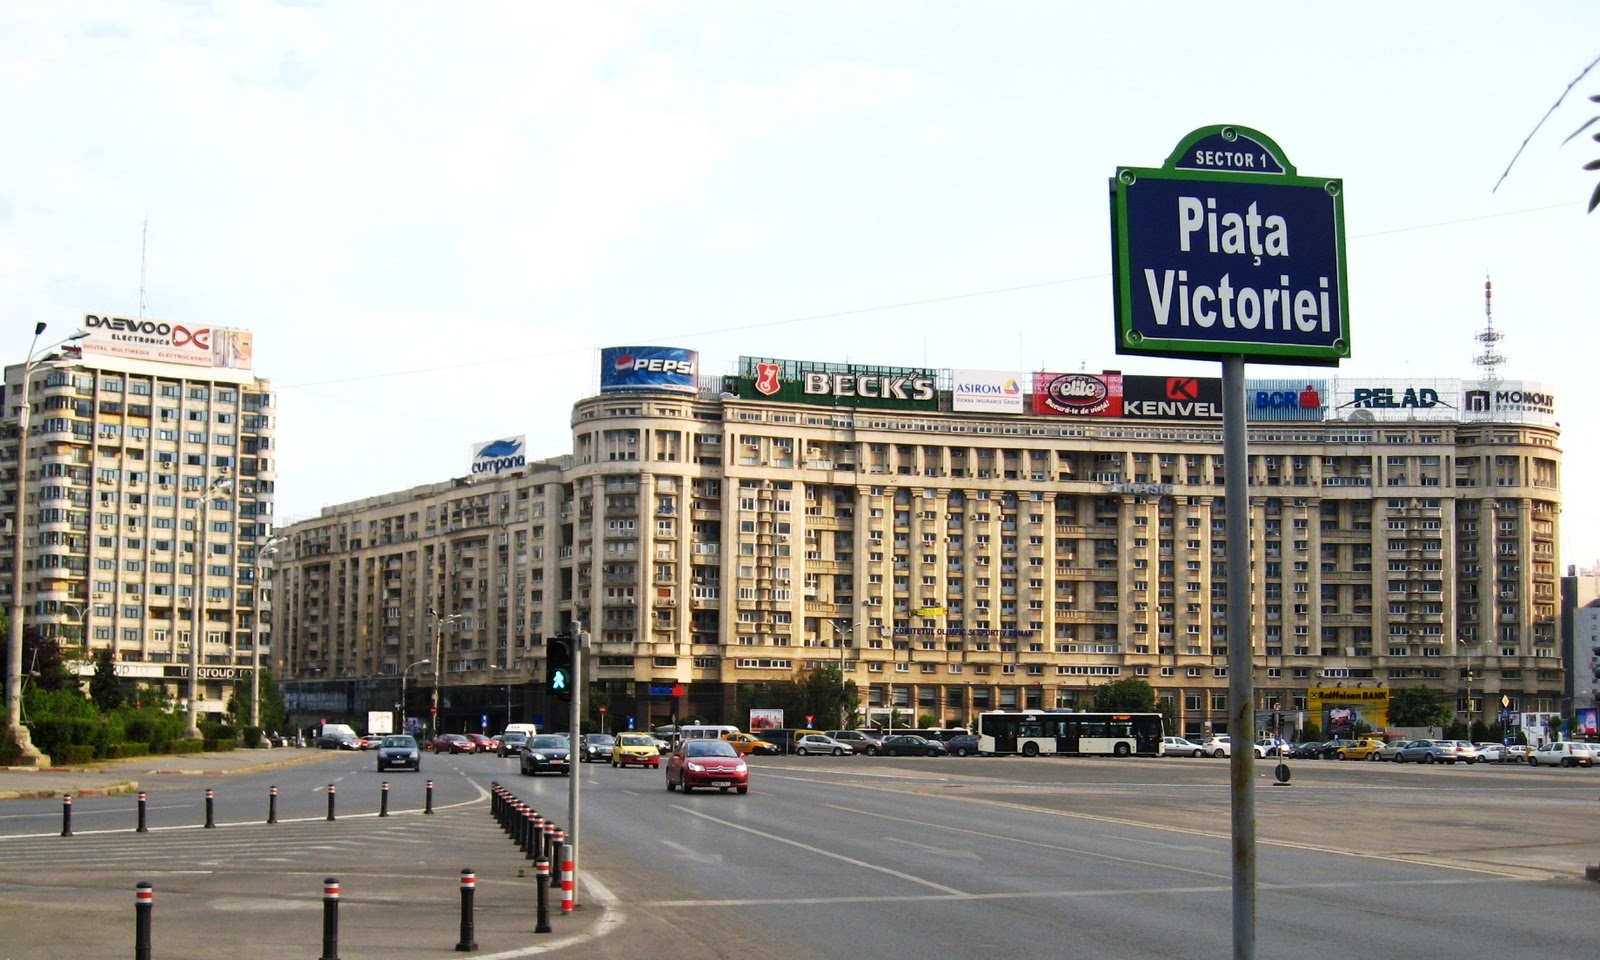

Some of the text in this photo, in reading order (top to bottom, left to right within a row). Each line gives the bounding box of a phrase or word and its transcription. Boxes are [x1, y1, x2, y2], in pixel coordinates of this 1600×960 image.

[1195, 150, 1267, 168] SECTOR 1
[1143, 268, 1331, 333] Victoriei
[85, 314, 170, 336] DAEWOO
[111, 333, 170, 346] ELECTRONICS
[82, 343, 107, 352] DIGITAL
[111, 347, 150, 356] MULTIMEDIA
[633, 358, 695, 375] PEPSI
[804, 371, 935, 401] BECK'S
[956, 383, 1002, 394] ASIROM
[1060, 380, 1096, 397] elite
[1256, 391, 1298, 408] BCR
[1354, 388, 1438, 408] RELAD
[472, 454, 525, 474] cumpana
